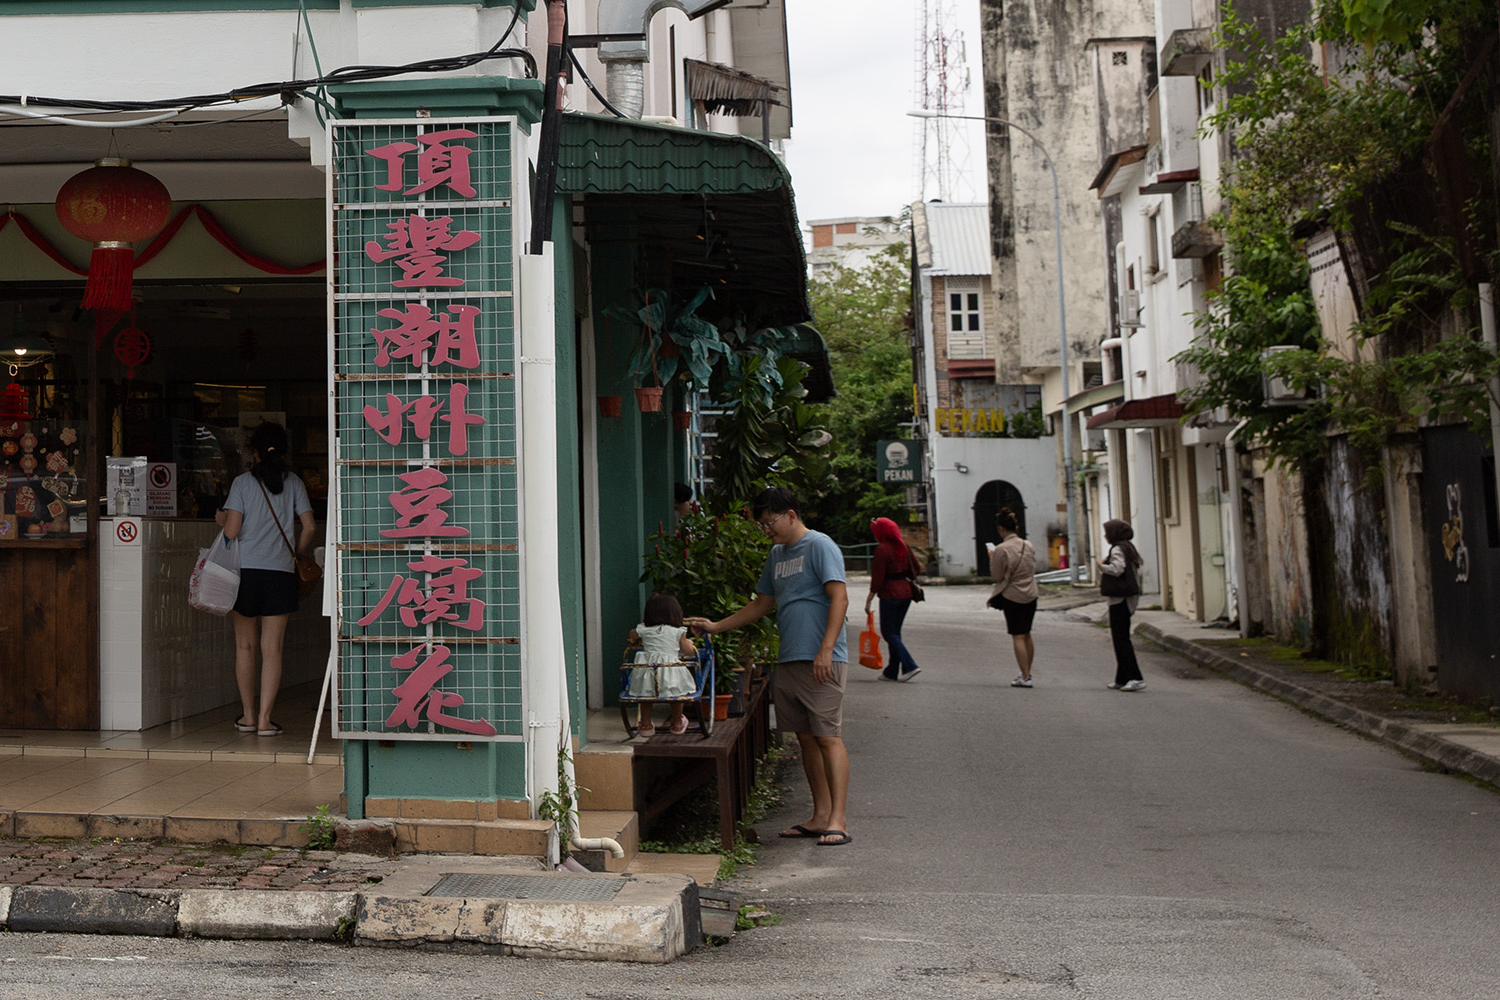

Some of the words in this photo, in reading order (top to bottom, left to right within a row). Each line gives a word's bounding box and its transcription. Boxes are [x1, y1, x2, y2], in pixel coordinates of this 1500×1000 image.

[934, 408, 1004, 432] PEKAN
[884, 469, 914, 481] PEKAN
[774, 554, 805, 580] PUMA
